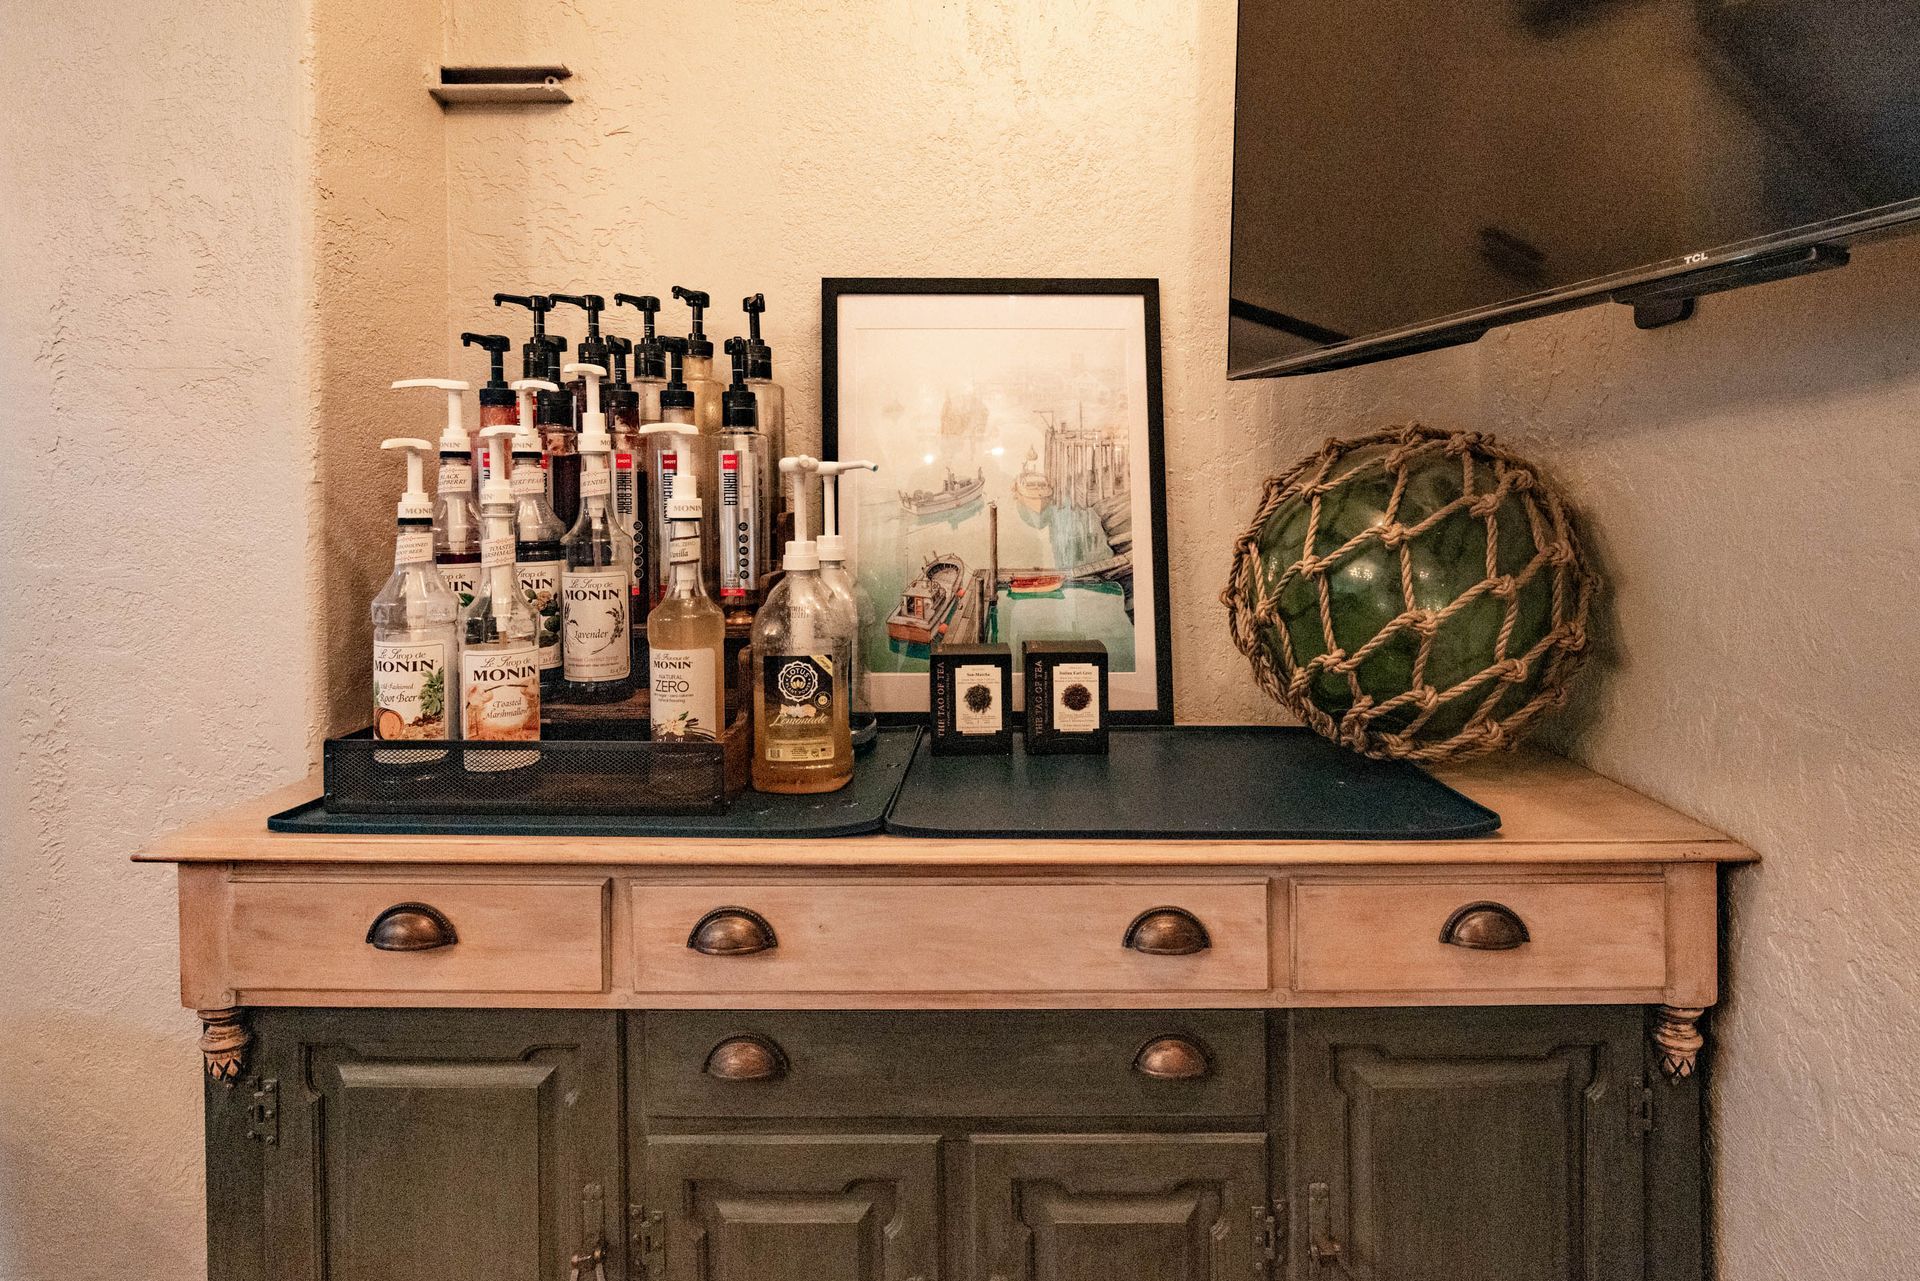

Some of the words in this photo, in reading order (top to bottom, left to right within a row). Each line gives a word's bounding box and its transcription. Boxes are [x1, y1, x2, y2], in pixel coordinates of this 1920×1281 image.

[1684, 252, 1709, 265] TCL
[616, 471, 632, 492] THREE
[723, 472, 738, 506] VANILLA
[617, 492, 633, 515] BERRY
[536, 570, 547, 578] de
[568, 579, 579, 589] Le
[580, 578, 602, 590] Sirop
[565, 588, 620, 601] MONIN
[574, 628, 609, 645] Lavender
[378, 648, 388, 659] Le
[389, 648, 413, 661] Sirop
[414, 651, 426, 659] de
[480, 656, 496, 668] Le
[496, 655, 522, 668] Sirop
[522, 657, 531, 665] de
[374, 659, 435, 673] MONIN
[653, 660, 692, 670] MONIN
[936, 661, 945, 681] TEA
[1034, 660, 1043, 679] TEA
[473, 664, 536, 682] MONIN
[785, 667, 811, 679] LOTUS
[655, 679, 690, 693] ZERO
[937, 682, 945, 696] OF
[396, 690, 417, 703] Beer
[492, 697, 522, 708] Toasted
[486, 707, 528, 719] Marshmallow
[937, 697, 945, 717] TAO
[769, 712, 828, 728] Lemonade
[937, 719, 945, 738] THE
